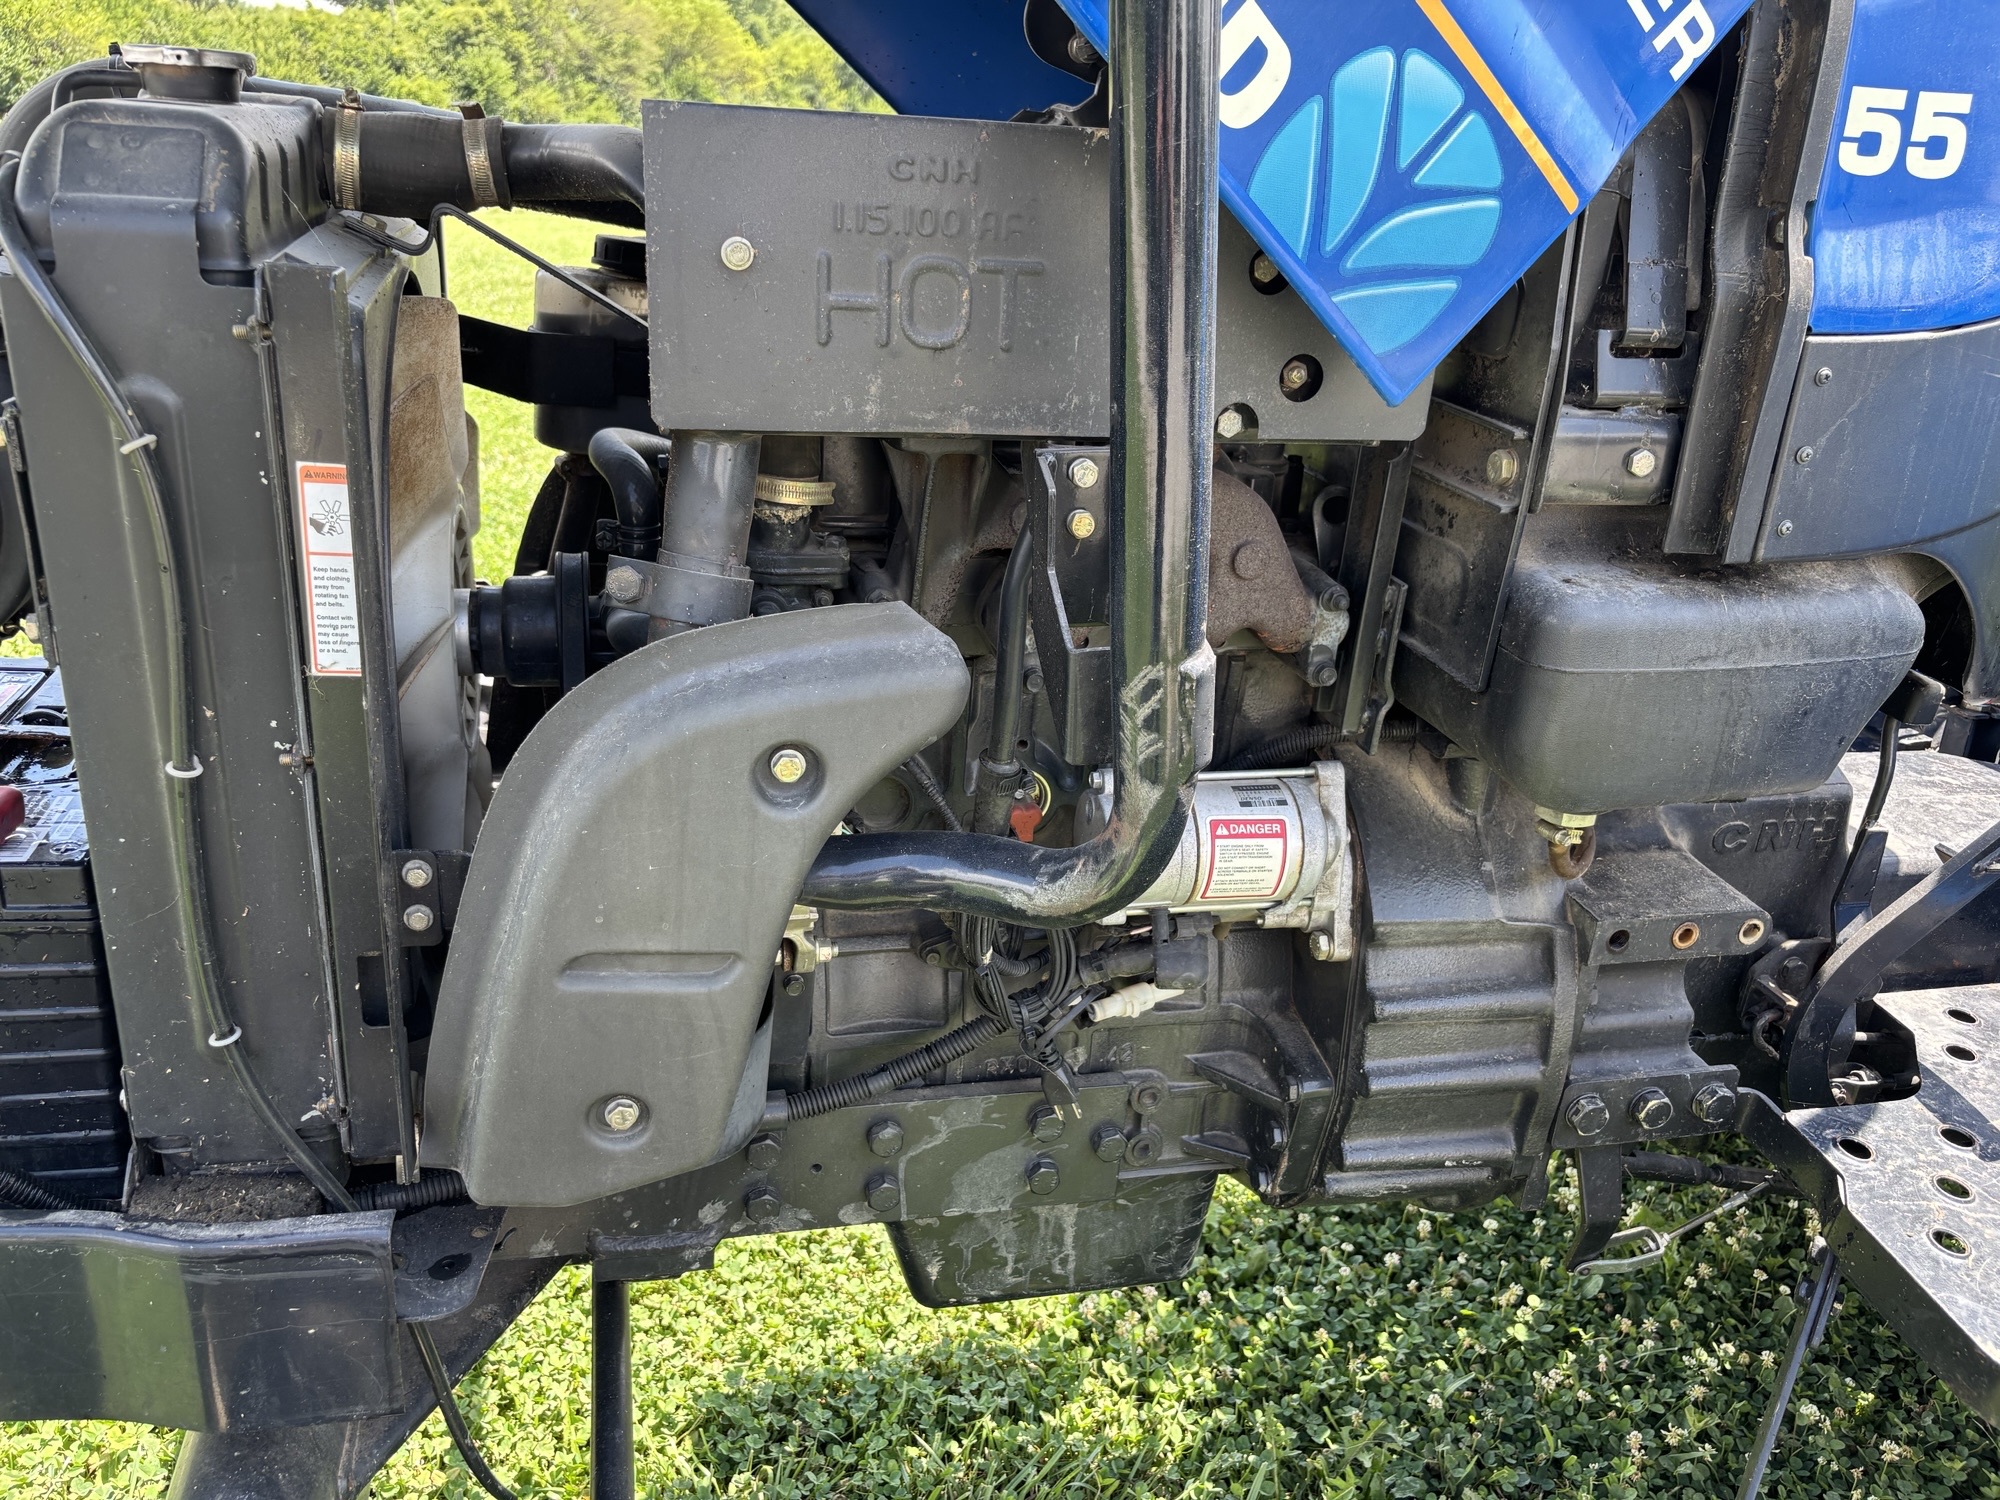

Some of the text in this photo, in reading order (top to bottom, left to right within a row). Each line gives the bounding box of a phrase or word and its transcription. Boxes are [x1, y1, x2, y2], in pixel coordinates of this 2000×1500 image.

[1838, 86, 1973, 179] 55
[816, 251, 1045, 352] HOT
[313, 471, 347, 480] WARNIN
[315, 592, 338, 600] rotating
[1229, 823, 1281, 835] DANGER
